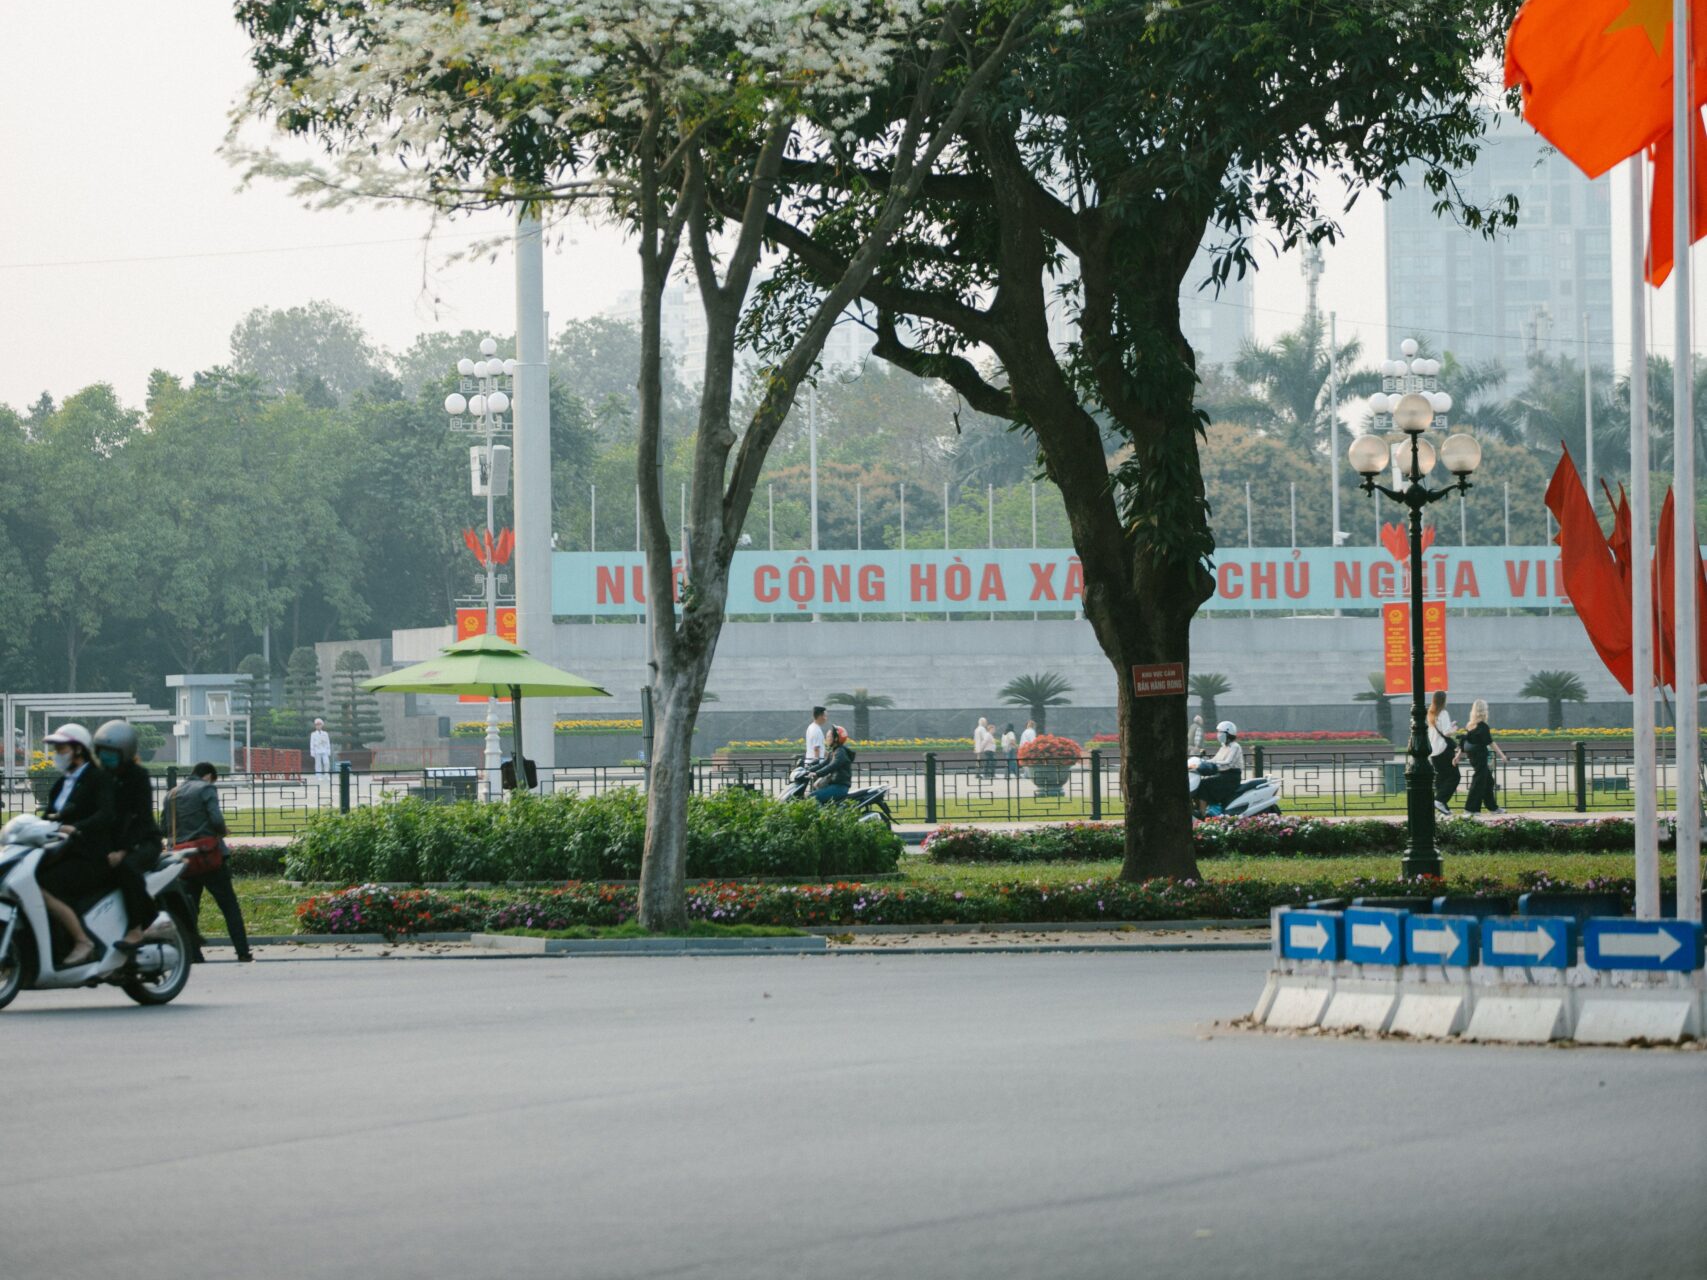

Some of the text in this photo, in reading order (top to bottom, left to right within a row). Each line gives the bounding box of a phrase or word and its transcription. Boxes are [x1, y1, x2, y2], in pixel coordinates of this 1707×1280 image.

[754, 556, 885, 610] CỘNG
[910, 556, 1007, 601] HÒA
[1029, 556, 1083, 601] XÃ
[1217, 549, 1310, 599] CHỦ
[1505, 549, 1569, 604] VI
